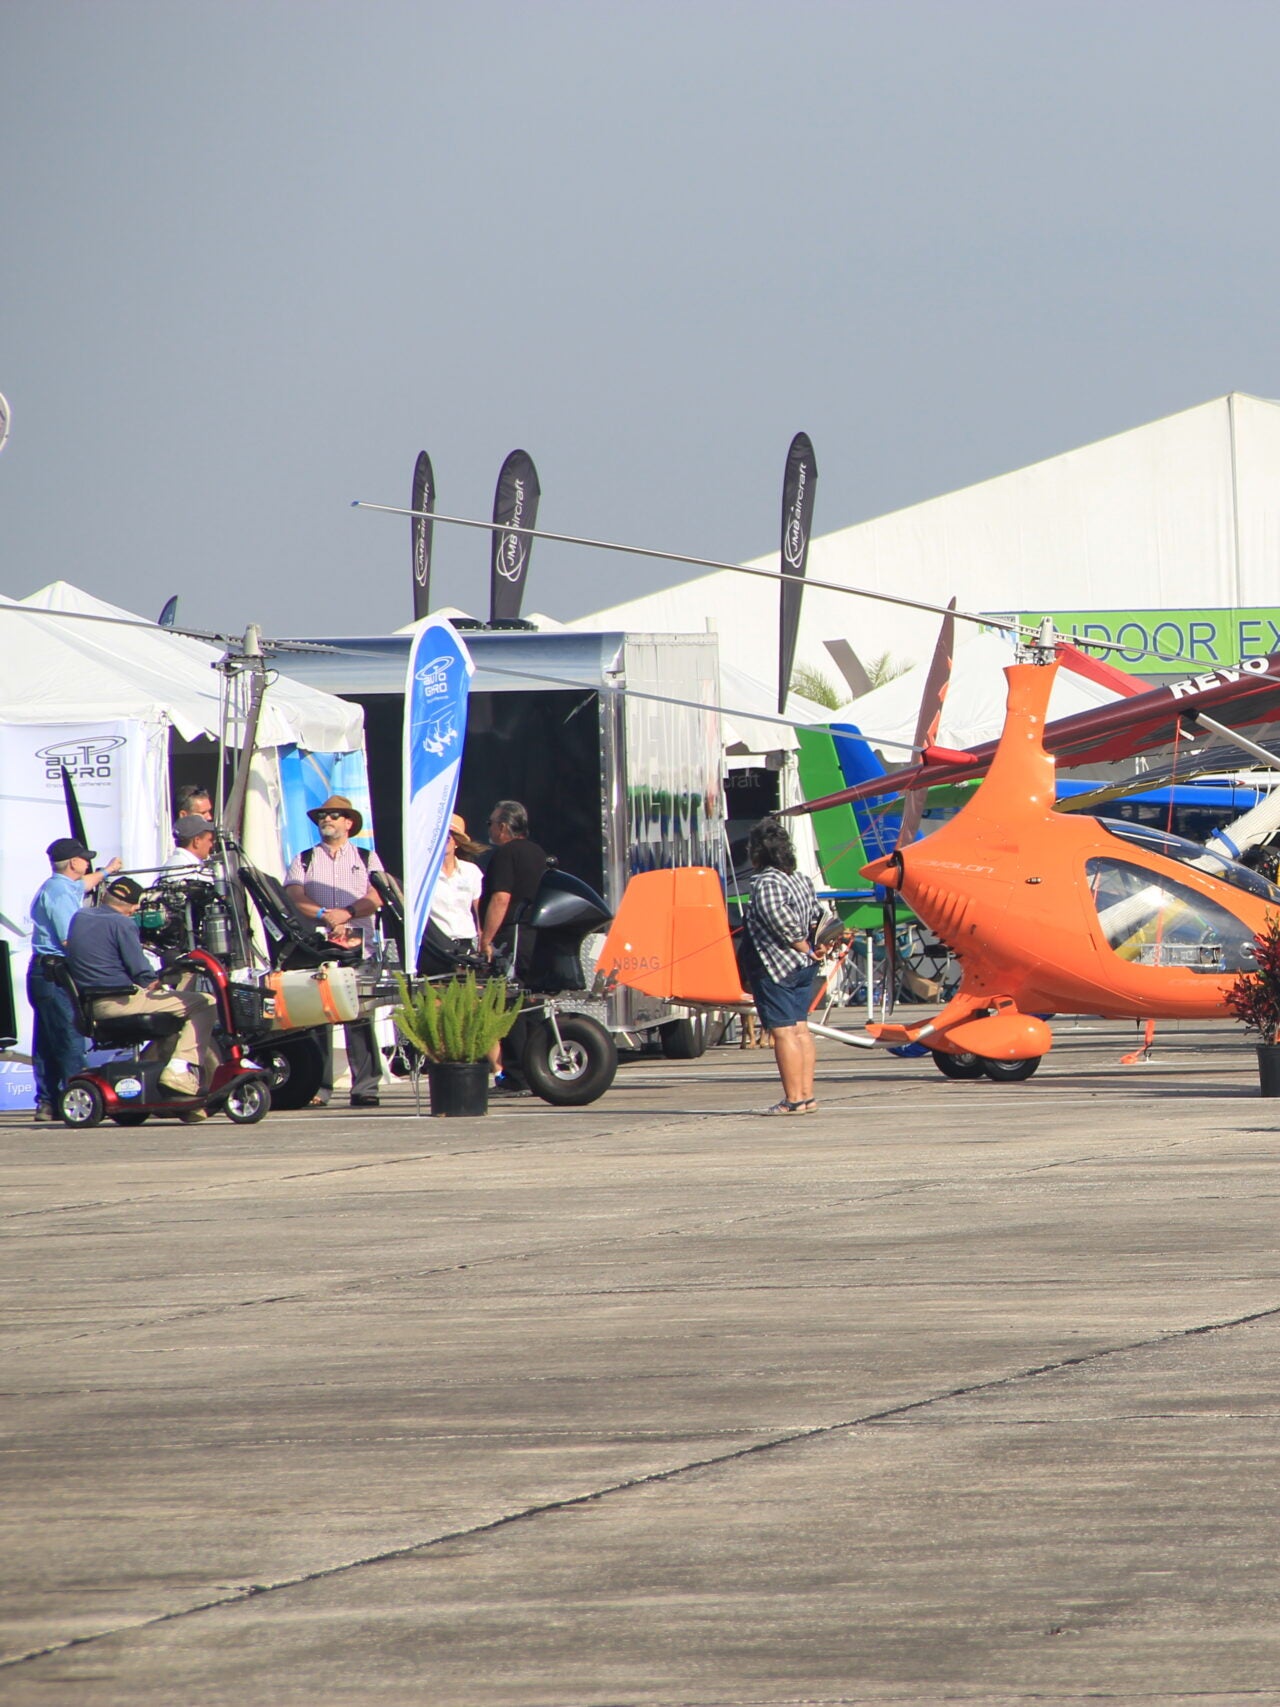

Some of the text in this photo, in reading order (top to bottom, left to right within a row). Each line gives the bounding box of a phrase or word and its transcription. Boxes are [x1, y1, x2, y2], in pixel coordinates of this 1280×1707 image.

[420, 482, 430, 538] airraft
[791, 461, 807, 552] JMB aircraft
[507, 533, 519, 566] JMB
[1052, 622, 1219, 662] NDOOR
[1169, 657, 1270, 700] REVO
[45, 766, 111, 780] GYRO
[613, 956, 660, 970] N89AG
[6, 1082, 32, 1094] Type
